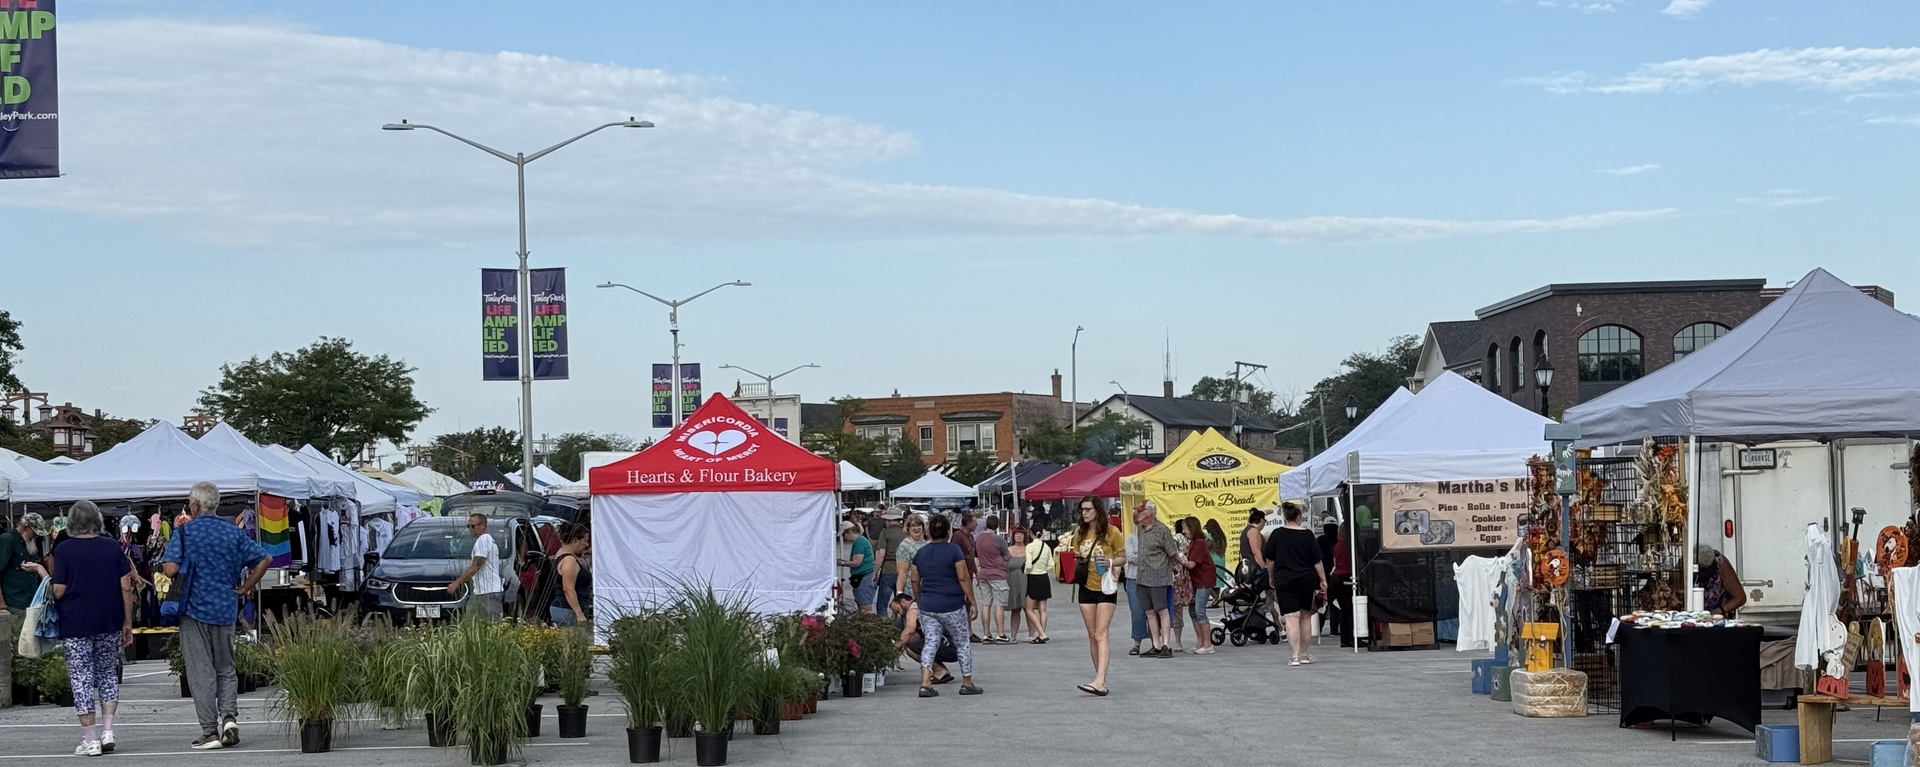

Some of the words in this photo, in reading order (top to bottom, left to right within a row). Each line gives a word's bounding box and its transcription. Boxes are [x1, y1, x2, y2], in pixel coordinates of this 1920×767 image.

[0, 76, 31, 104] D
[483, 292, 501, 304] Tinley
[501, 294, 518, 304] Park
[532, 291, 549, 304] Tinley
[549, 293, 565, 303] Park
[484, 315, 518, 327] AMP
[533, 315, 566, 327] AMP
[676, 416, 759, 442] MISERICORDIA
[673, 448, 703, 462] HEART
[726, 443, 760, 462] MERCY
[627, 470, 675, 484] Hearts
[679, 469, 695, 483] &
[699, 469, 739, 483] Flour
[744, 468, 798, 485] Bakery
[1161, 480, 1189, 492] Fresh
[1190, 478, 1219, 490] Baked
[1220, 476, 1255, 488] Artisan
[1437, 479, 1509, 495] Martha's
[1194, 494, 1216, 508] Our
[1217, 493, 1256, 507] Breads
[1438, 504, 1458, 512] Pies
[1467, 502, 1491, 511] Rolls
[1471, 514, 1506, 523] Cookies
[1475, 524, 1503, 532] Butter
[1480, 534, 1502, 543] Eggs
